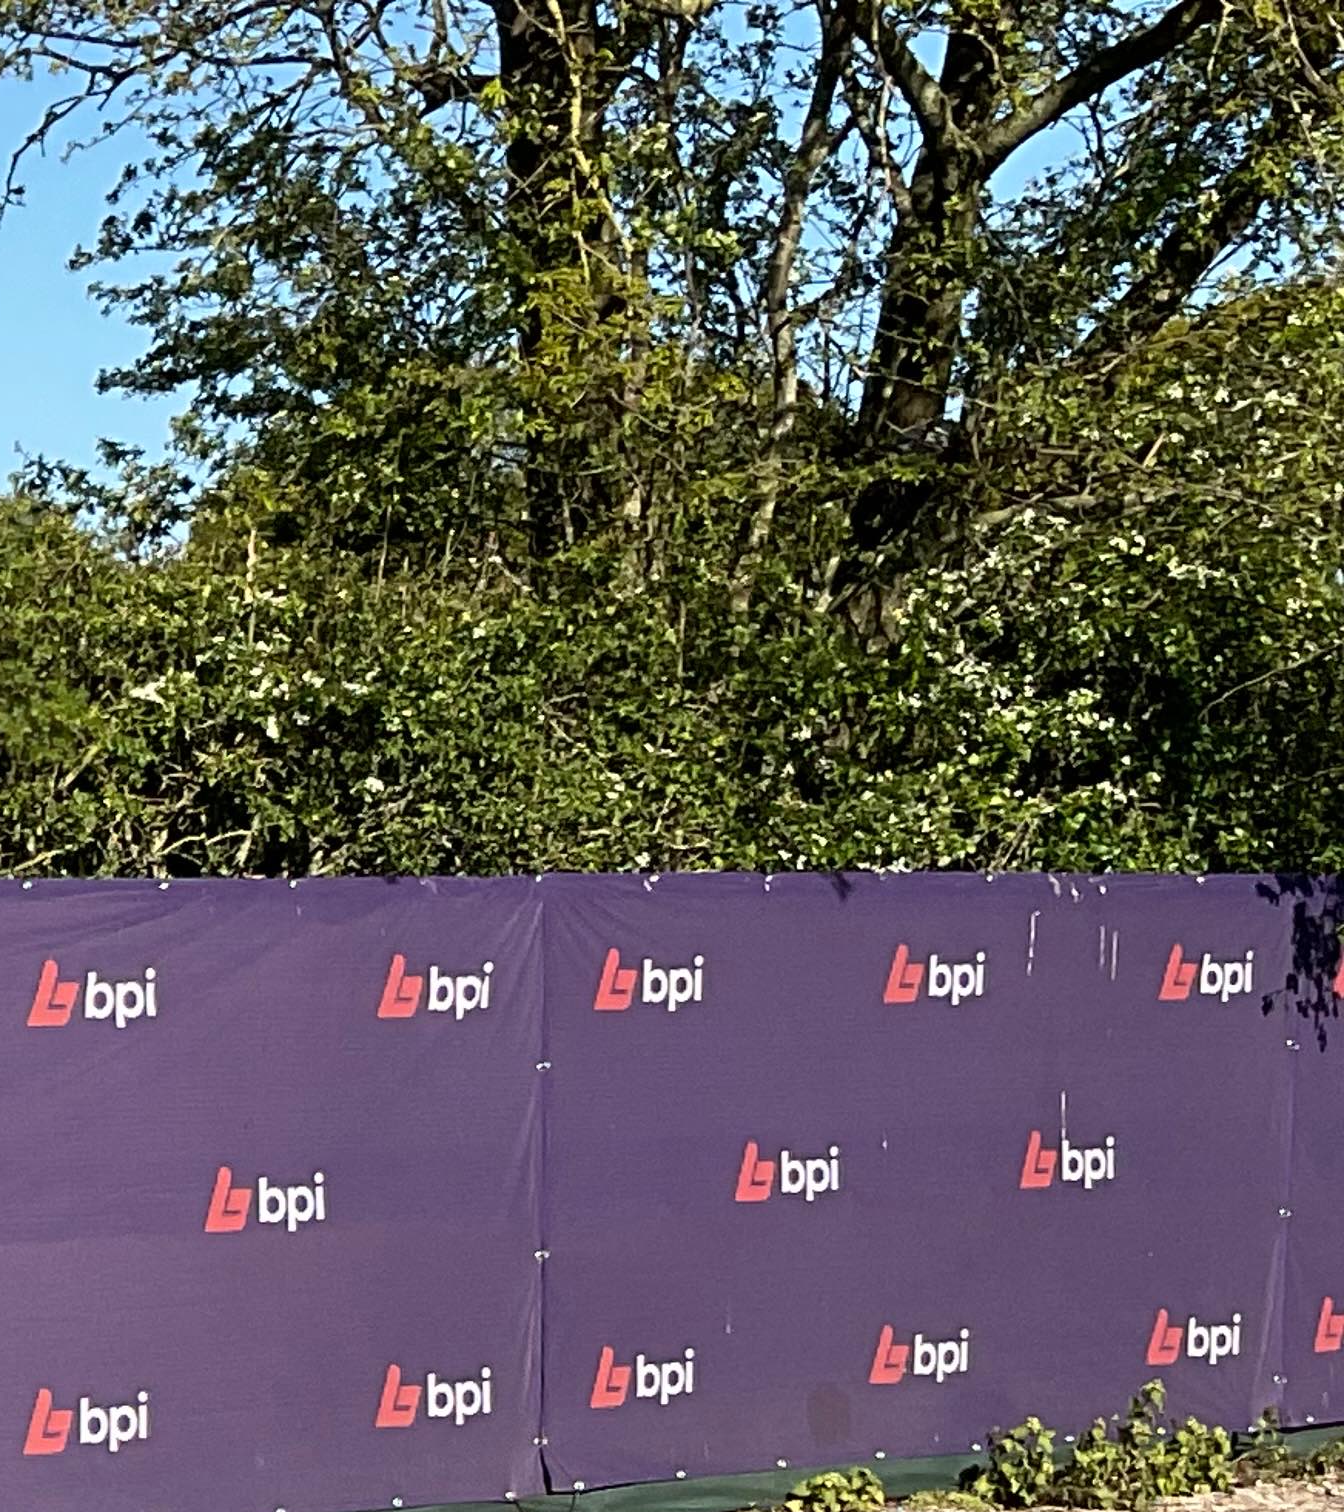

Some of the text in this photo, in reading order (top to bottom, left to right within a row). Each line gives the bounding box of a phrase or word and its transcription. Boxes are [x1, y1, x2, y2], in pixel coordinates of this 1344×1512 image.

[84, 967, 157, 1029] bpi
[427, 961, 494, 1020] bpi
[642, 955, 704, 1012] bpi
[928, 951, 986, 1006] bpi
[1200, 950, 1254, 1003] bpi
[781, 1146, 839, 1202] bpi
[1061, 1136, 1115, 1189] bpi
[258, 1172, 326, 1232] bpi
[913, 1328, 969, 1383] bpi
[1187, 1313, 1242, 1365] bpi
[427, 1366, 492, 1425] bpi
[636, 1348, 695, 1405] bpi
[79, 1391, 149, 1453] bpi
